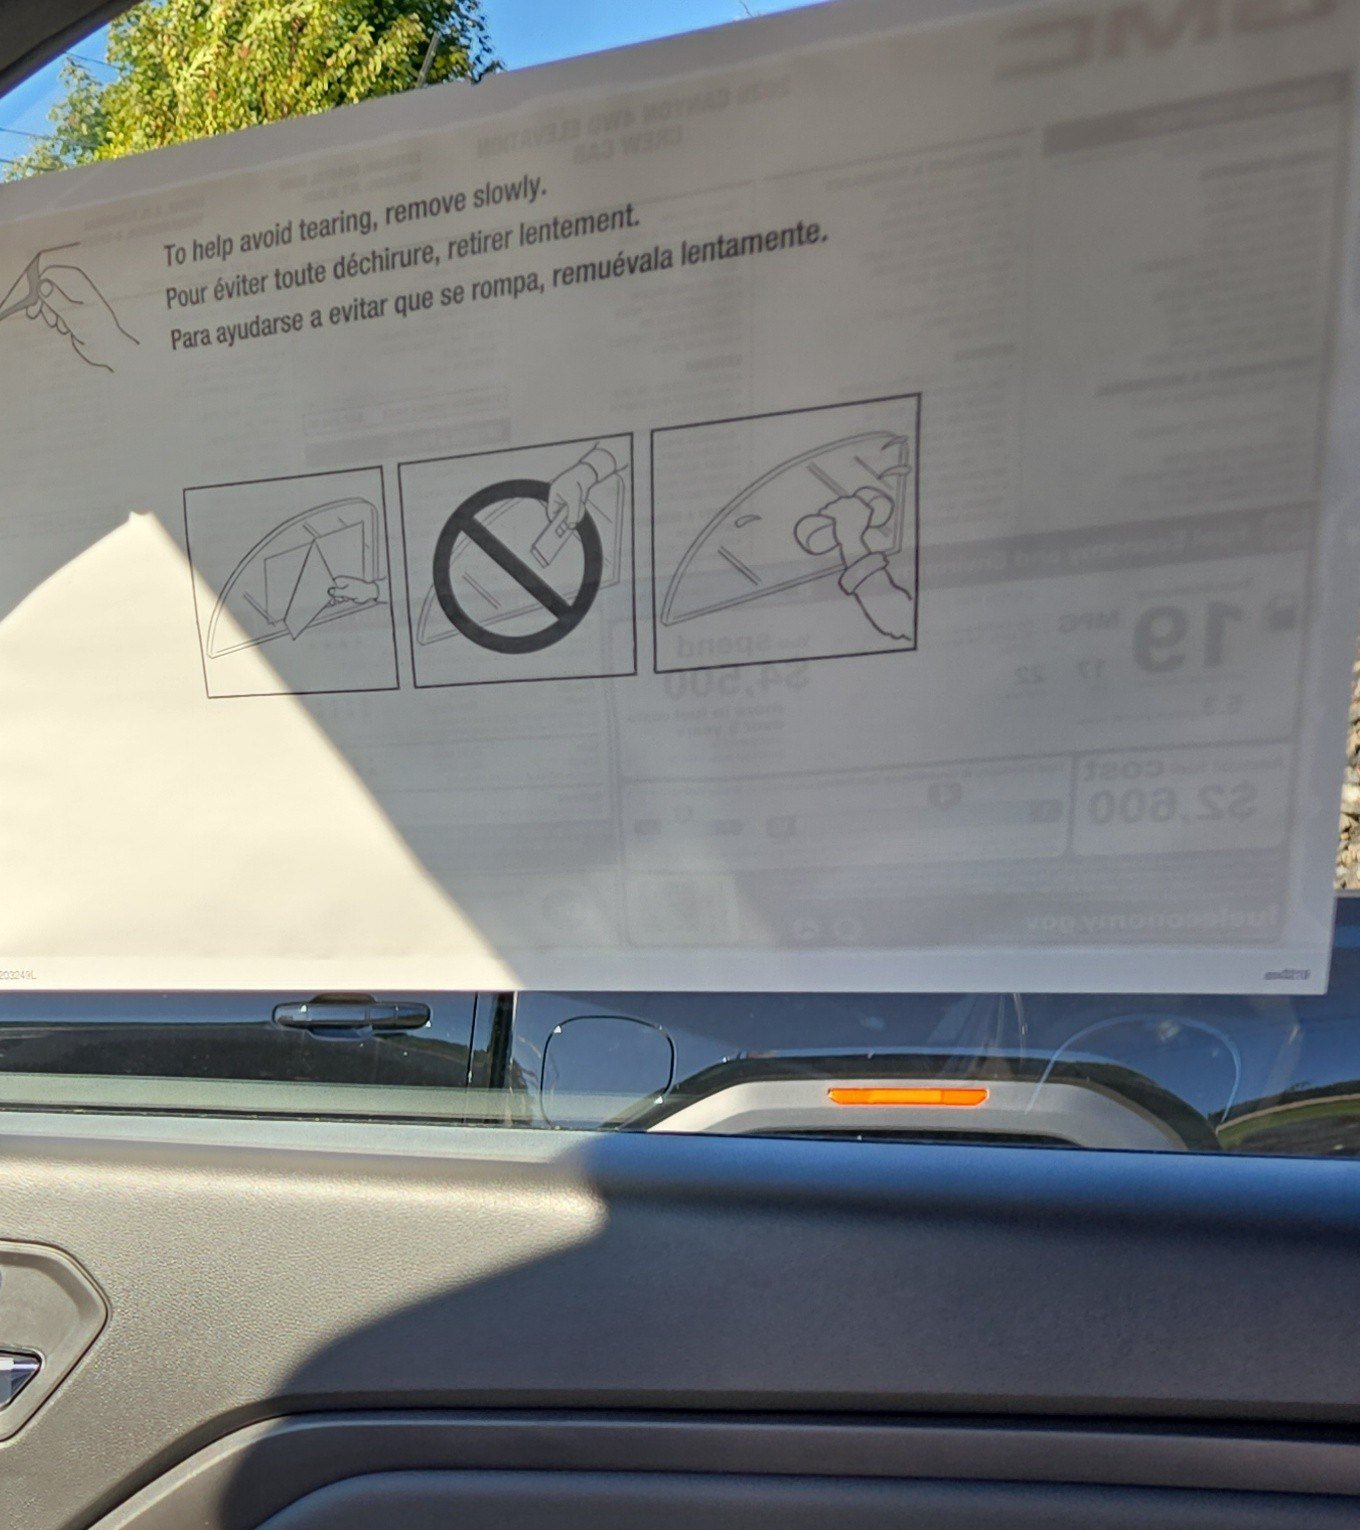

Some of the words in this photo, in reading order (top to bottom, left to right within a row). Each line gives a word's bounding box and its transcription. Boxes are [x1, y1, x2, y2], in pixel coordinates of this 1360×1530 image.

[164, 243, 187, 267] To
[192, 233, 233, 262] help
[240, 220, 293, 253] avoid
[300, 210, 379, 241] tearing,
[385, 191, 467, 225] remove
[473, 174, 547, 209] slowly.
[166, 284, 208, 310] Pour
[214, 273, 269, 301] éviter
[275, 262, 327, 291] toute
[333, 243, 441, 281] déchirure,
[448, 229, 513, 260] retirer
[519, 203, 641, 247] lentement.
[171, 327, 212, 351] Para
[216, 315, 303, 348] ayudarse
[310, 309, 324, 329] a
[329, 297, 388, 325] evitar
[394, 290, 434, 318] que
[440, 284, 465, 307] se
[472, 270, 545, 300] rompa,
[552, 246, 674, 287] remuévala
[681, 220, 829, 266] lentamente.
